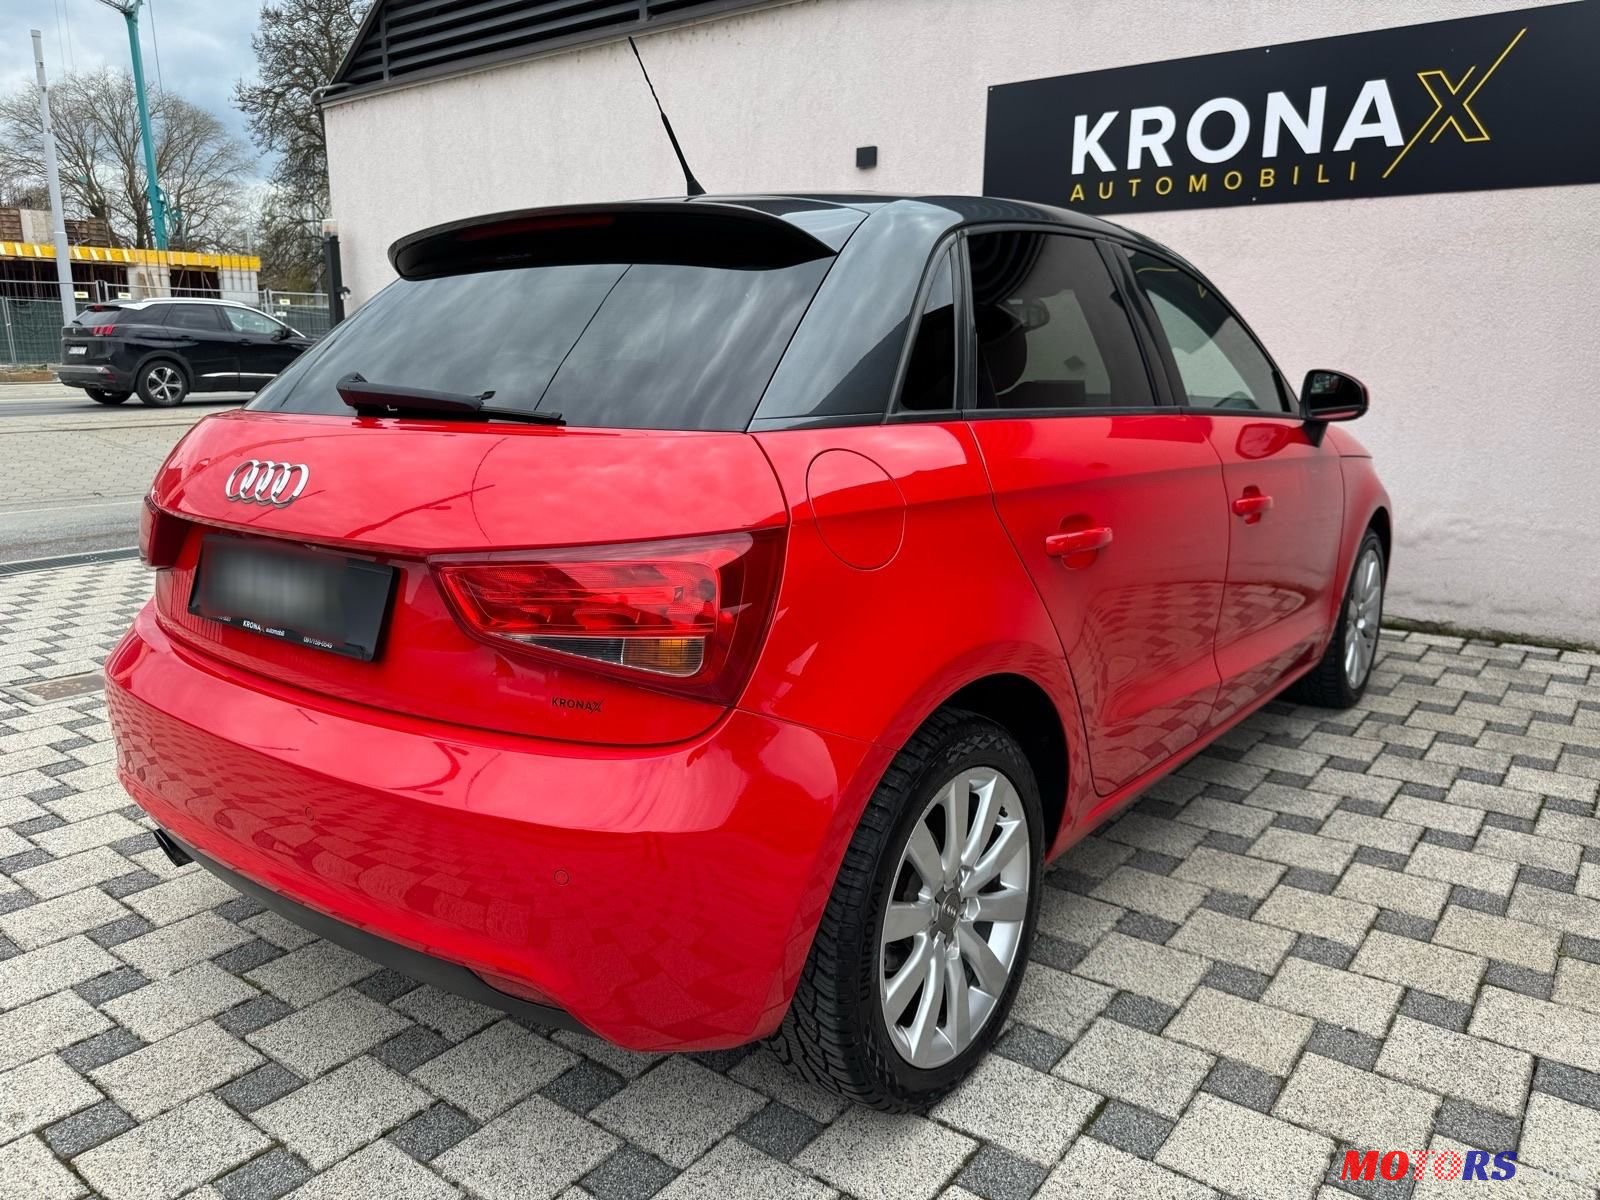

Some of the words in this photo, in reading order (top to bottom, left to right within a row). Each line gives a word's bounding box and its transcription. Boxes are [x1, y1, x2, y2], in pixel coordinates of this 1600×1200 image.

[1070, 27, 1527, 178] KRONAX
[1070, 161, 1356, 202] AUTOMOBILI
[551, 697, 603, 713] KRONAX
[861, 881, 883, 1001] UNIROYAL
